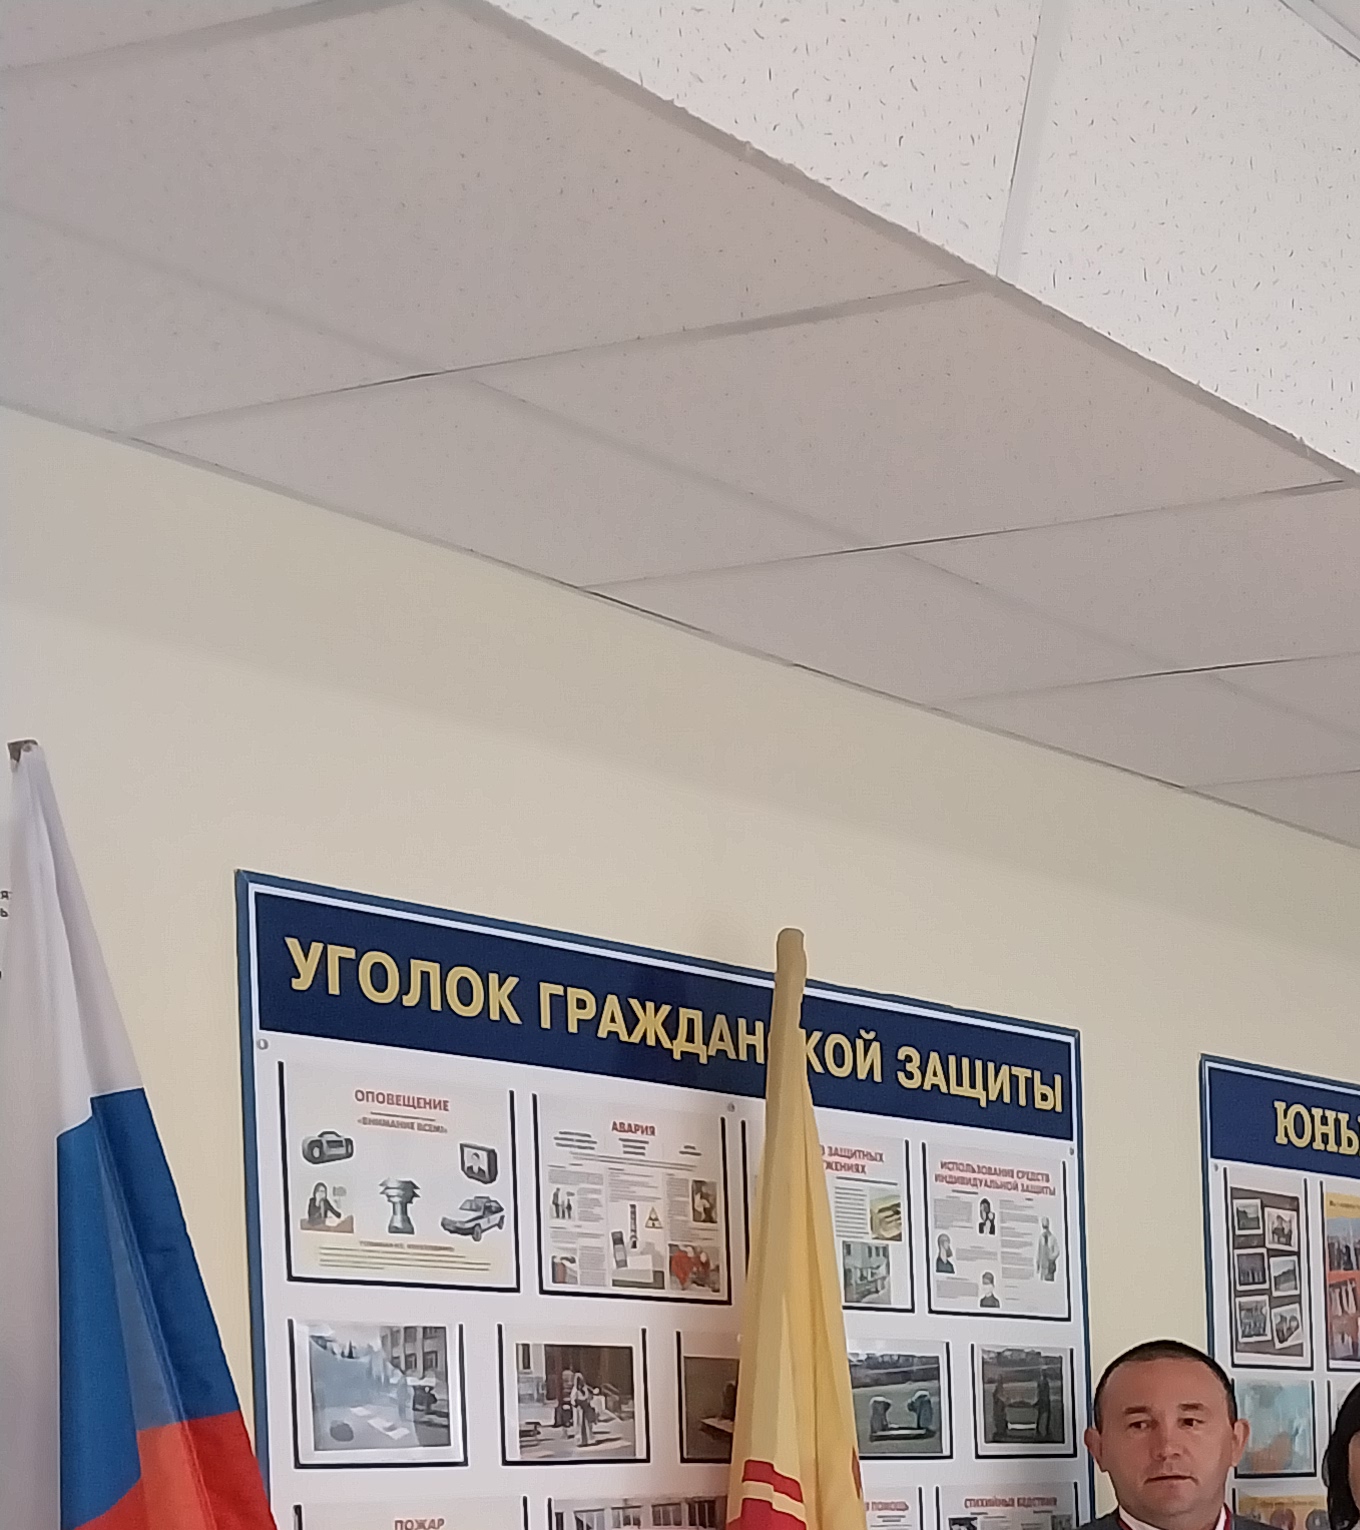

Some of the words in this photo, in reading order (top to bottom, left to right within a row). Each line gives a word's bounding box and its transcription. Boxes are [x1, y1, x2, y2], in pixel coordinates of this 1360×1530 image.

[284, 936, 523, 1025] УГОЛОК
[538, 981, 882, 1082] ГРАЖДАНКОЙ
[897, 1045, 1063, 1113] ЗАЩИТЫ
[355, 1089, 450, 1112] ОПОВЕЩЕНИЕ
[611, 1121, 656, 1136] АВАРИЯ
